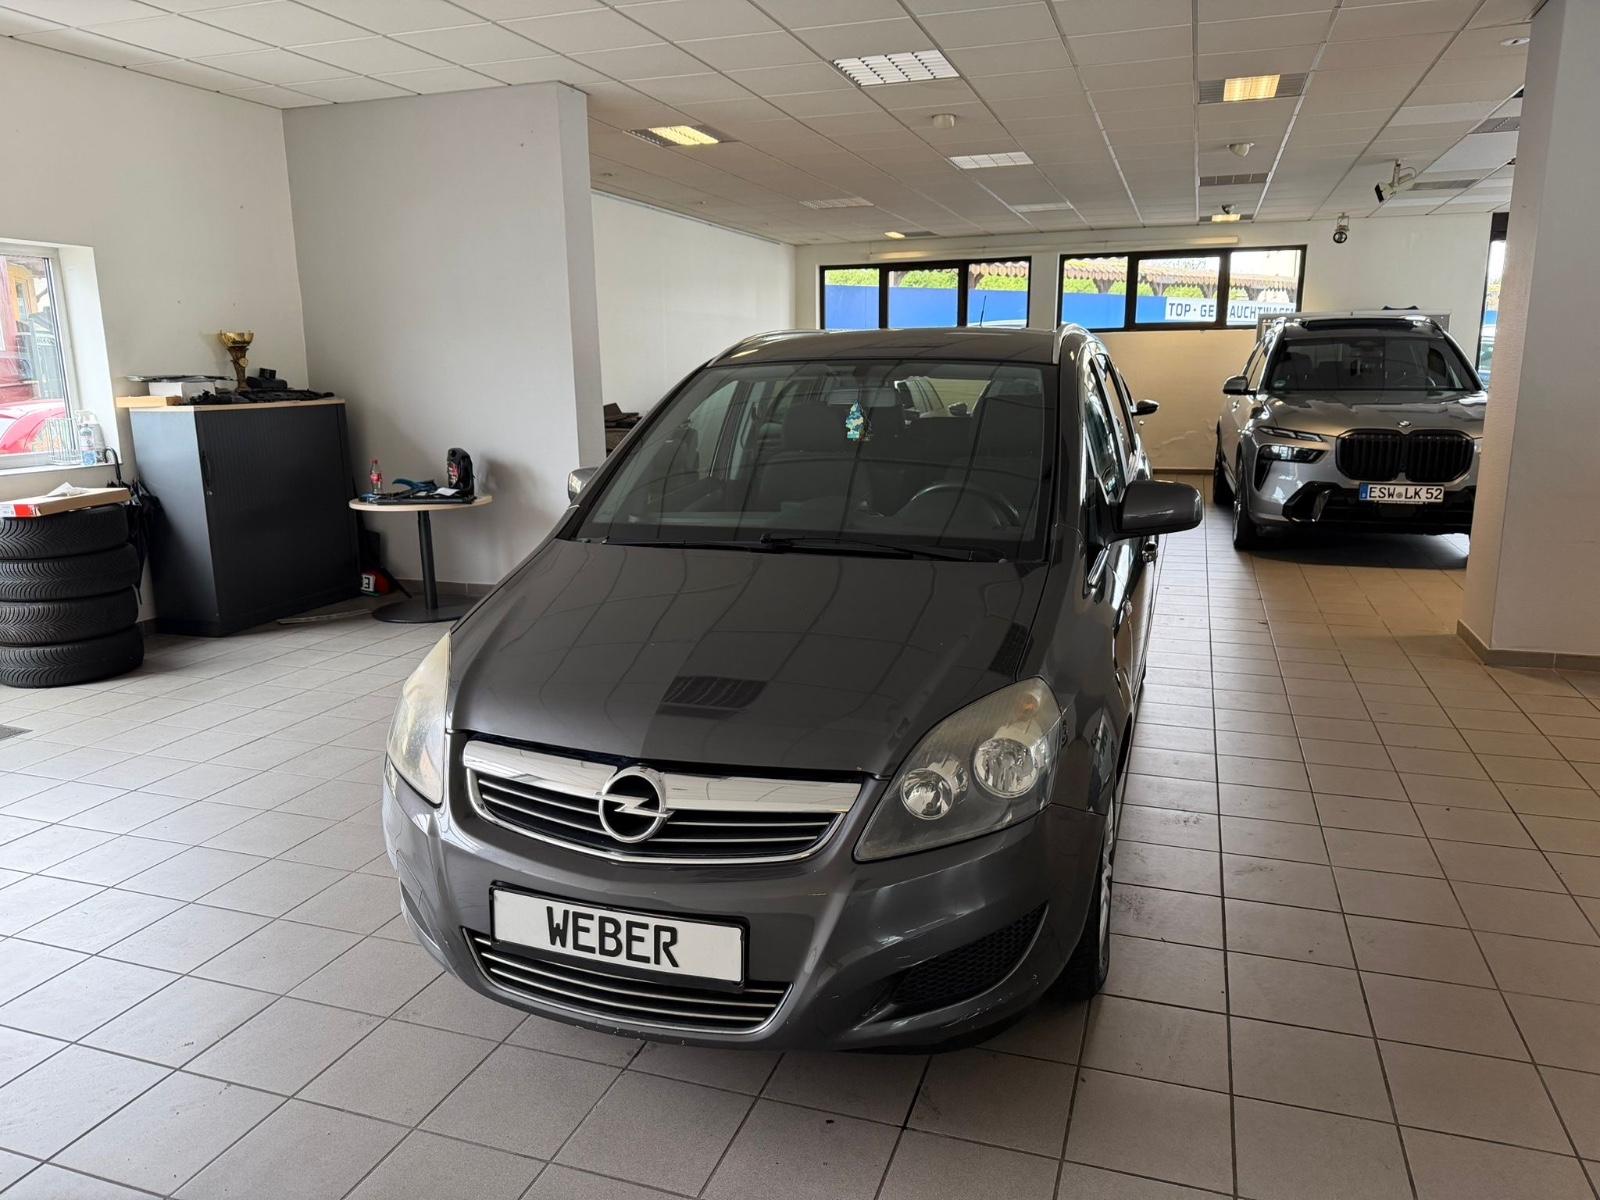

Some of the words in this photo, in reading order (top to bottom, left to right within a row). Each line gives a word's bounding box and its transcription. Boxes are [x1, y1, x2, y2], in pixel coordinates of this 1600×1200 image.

[1168, 302, 1191, 317] TOP
[1369, 486, 1396, 499] ESW
[1404, 487, 1423, 500] LK
[1425, 487, 1443, 500] 52
[546, 906, 679, 968] WEBER
